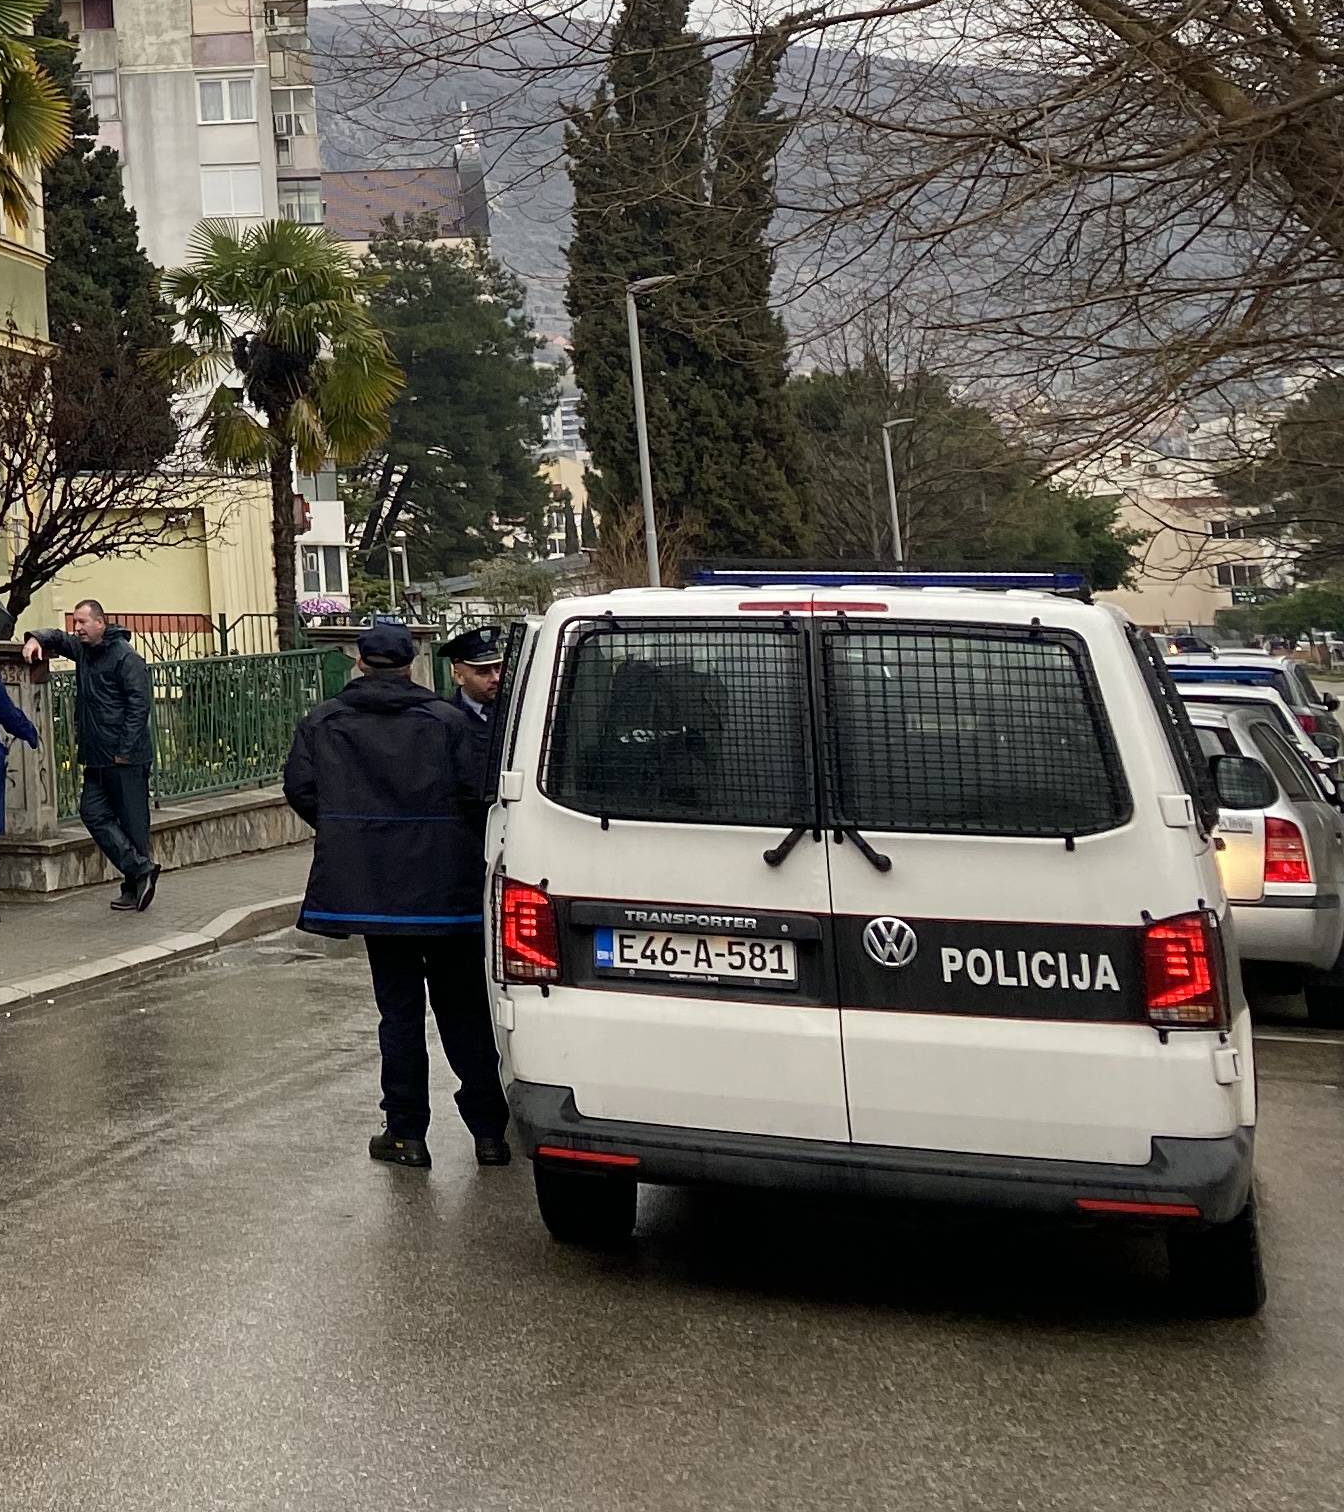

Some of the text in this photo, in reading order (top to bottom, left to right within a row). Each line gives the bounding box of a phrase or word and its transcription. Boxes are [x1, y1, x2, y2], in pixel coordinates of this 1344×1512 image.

[625, 909, 758, 930] TRANSPORTER
[618, 933, 789, 975] E46-A-581
[940, 946, 1121, 992] POLICIJA
